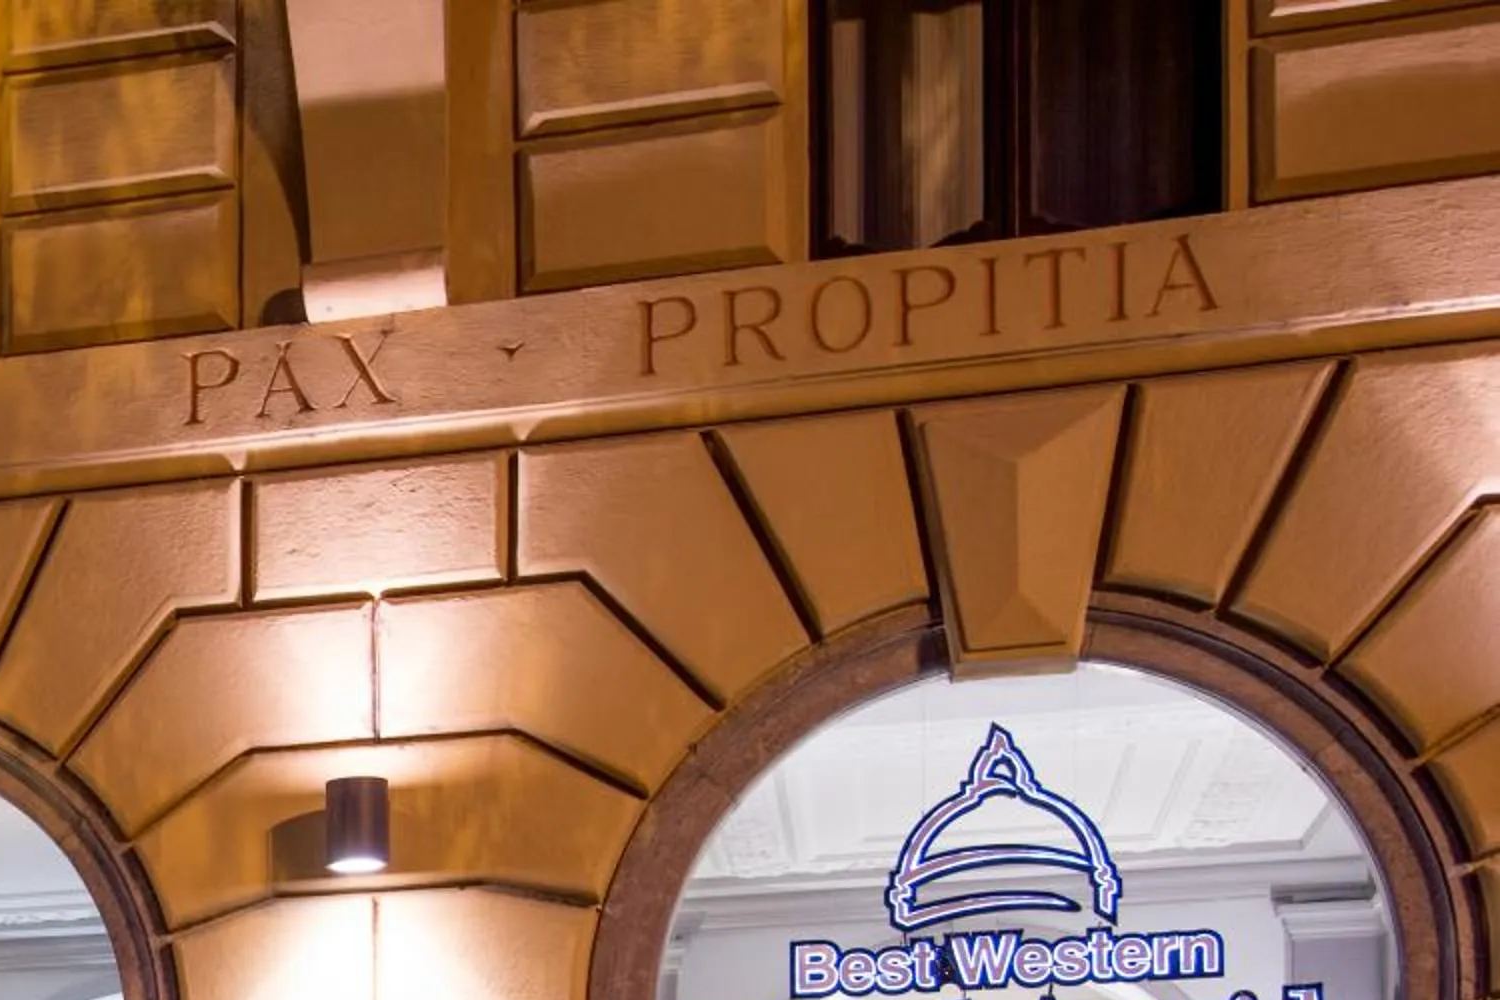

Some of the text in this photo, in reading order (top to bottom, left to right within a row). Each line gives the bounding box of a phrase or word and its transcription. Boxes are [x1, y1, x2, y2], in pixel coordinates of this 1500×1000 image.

[181, 325, 398, 425] PAX
[637, 234, 1221, 377] PROPITIA
[793, 930, 1222, 998] Best Western
